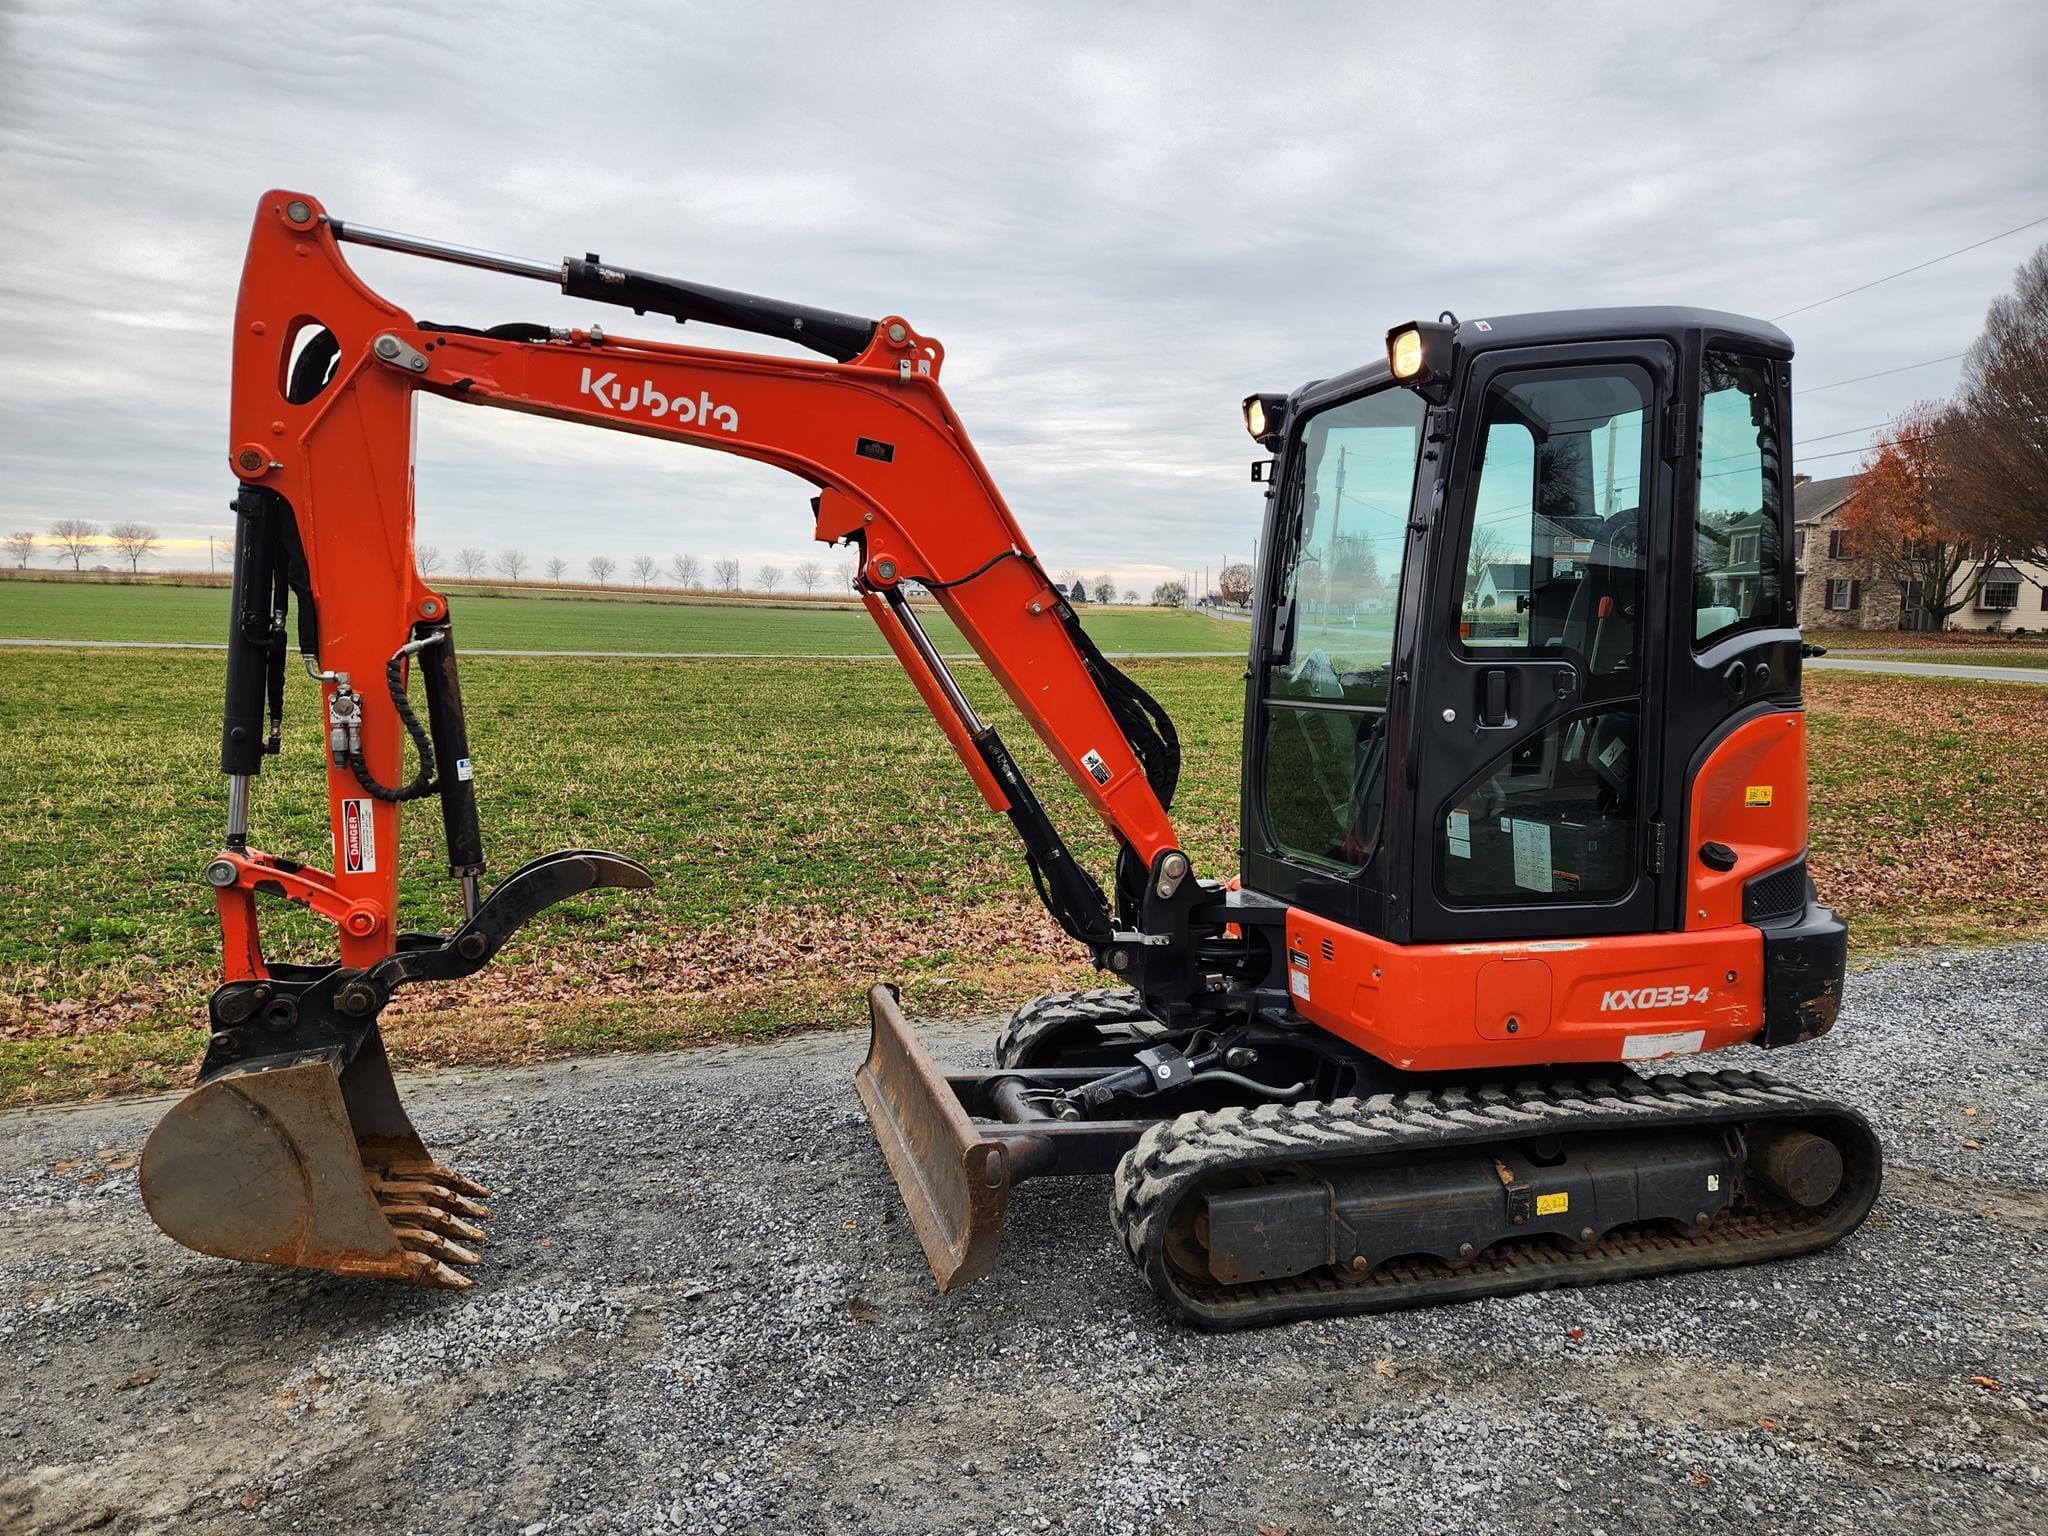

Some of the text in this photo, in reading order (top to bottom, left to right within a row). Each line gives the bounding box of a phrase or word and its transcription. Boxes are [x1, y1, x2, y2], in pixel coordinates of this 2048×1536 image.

[580, 367, 739, 432] Kubota
[349, 816, 359, 855] DANGER
[1600, 985, 1710, 1012] KX033-4
